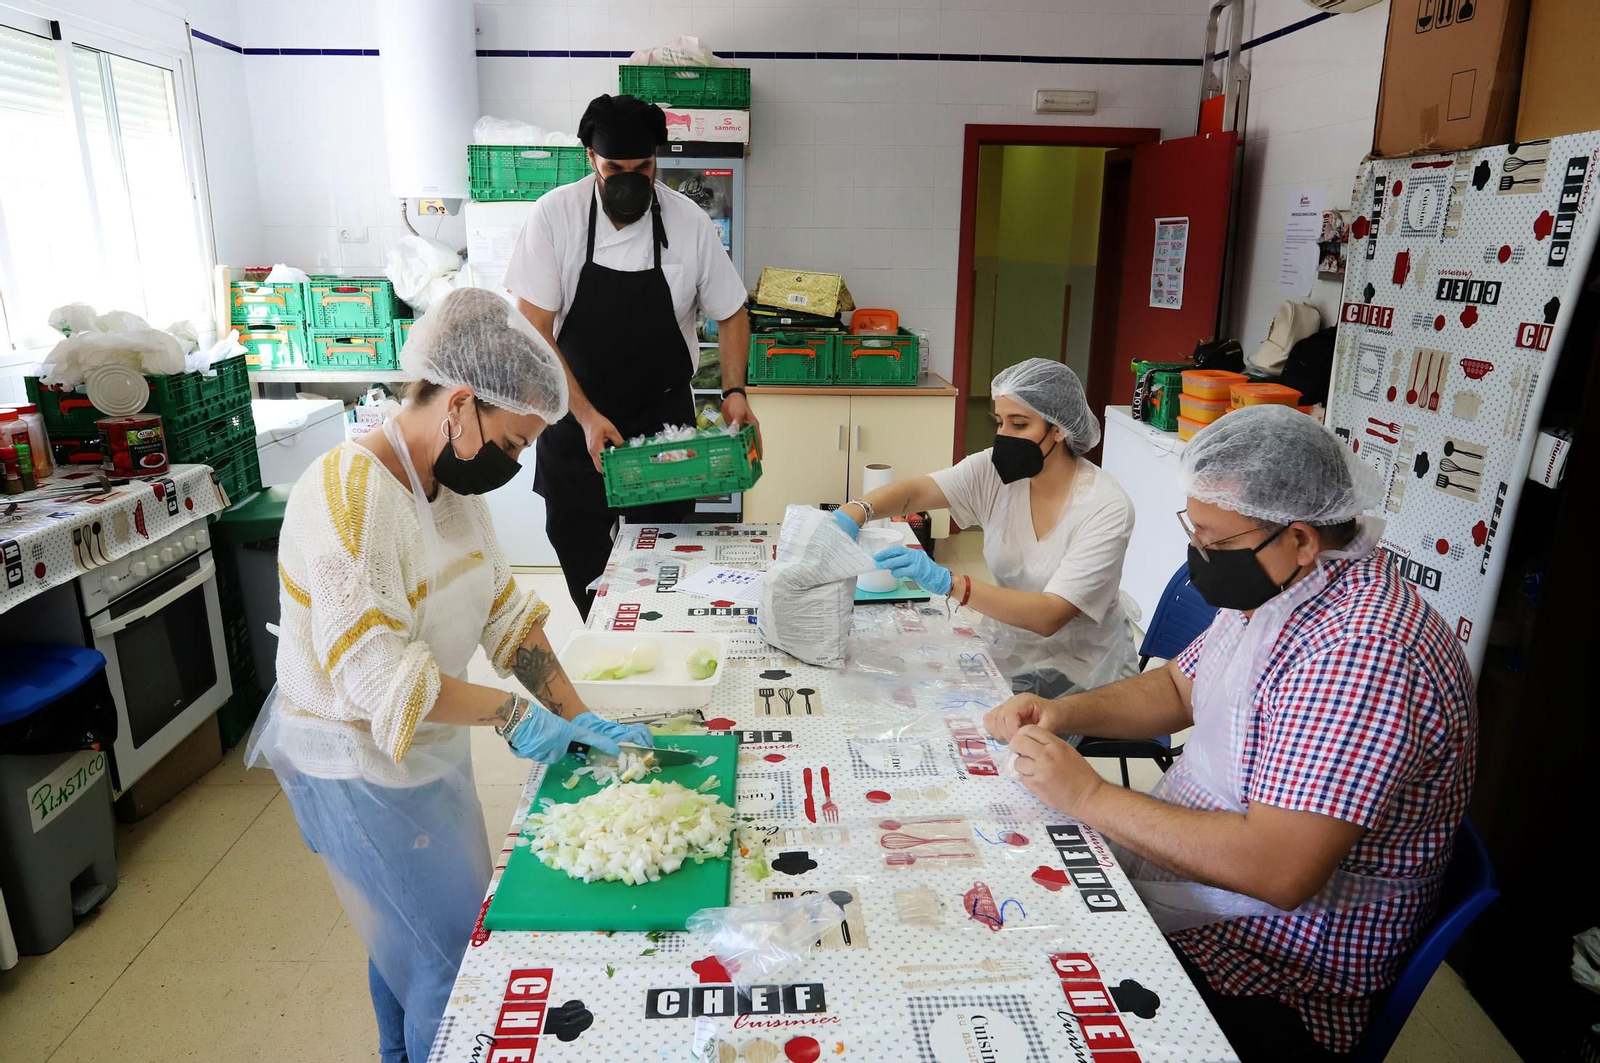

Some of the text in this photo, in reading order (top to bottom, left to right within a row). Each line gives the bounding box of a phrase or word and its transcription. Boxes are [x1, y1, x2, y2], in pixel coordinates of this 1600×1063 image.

[1368, 182, 1385, 255] CHEF
[1551, 165, 1584, 261] CHEF
[1440, 281, 1497, 304] CHEF
[1545, 440, 1562, 484] aluminio
[694, 608, 758, 616] CHE
[32, 754, 104, 820] PLASTICO
[1052, 832, 1118, 908] CHEF
[657, 986, 811, 1016] CHEF
[734, 1012, 842, 1030] Cuisinier
